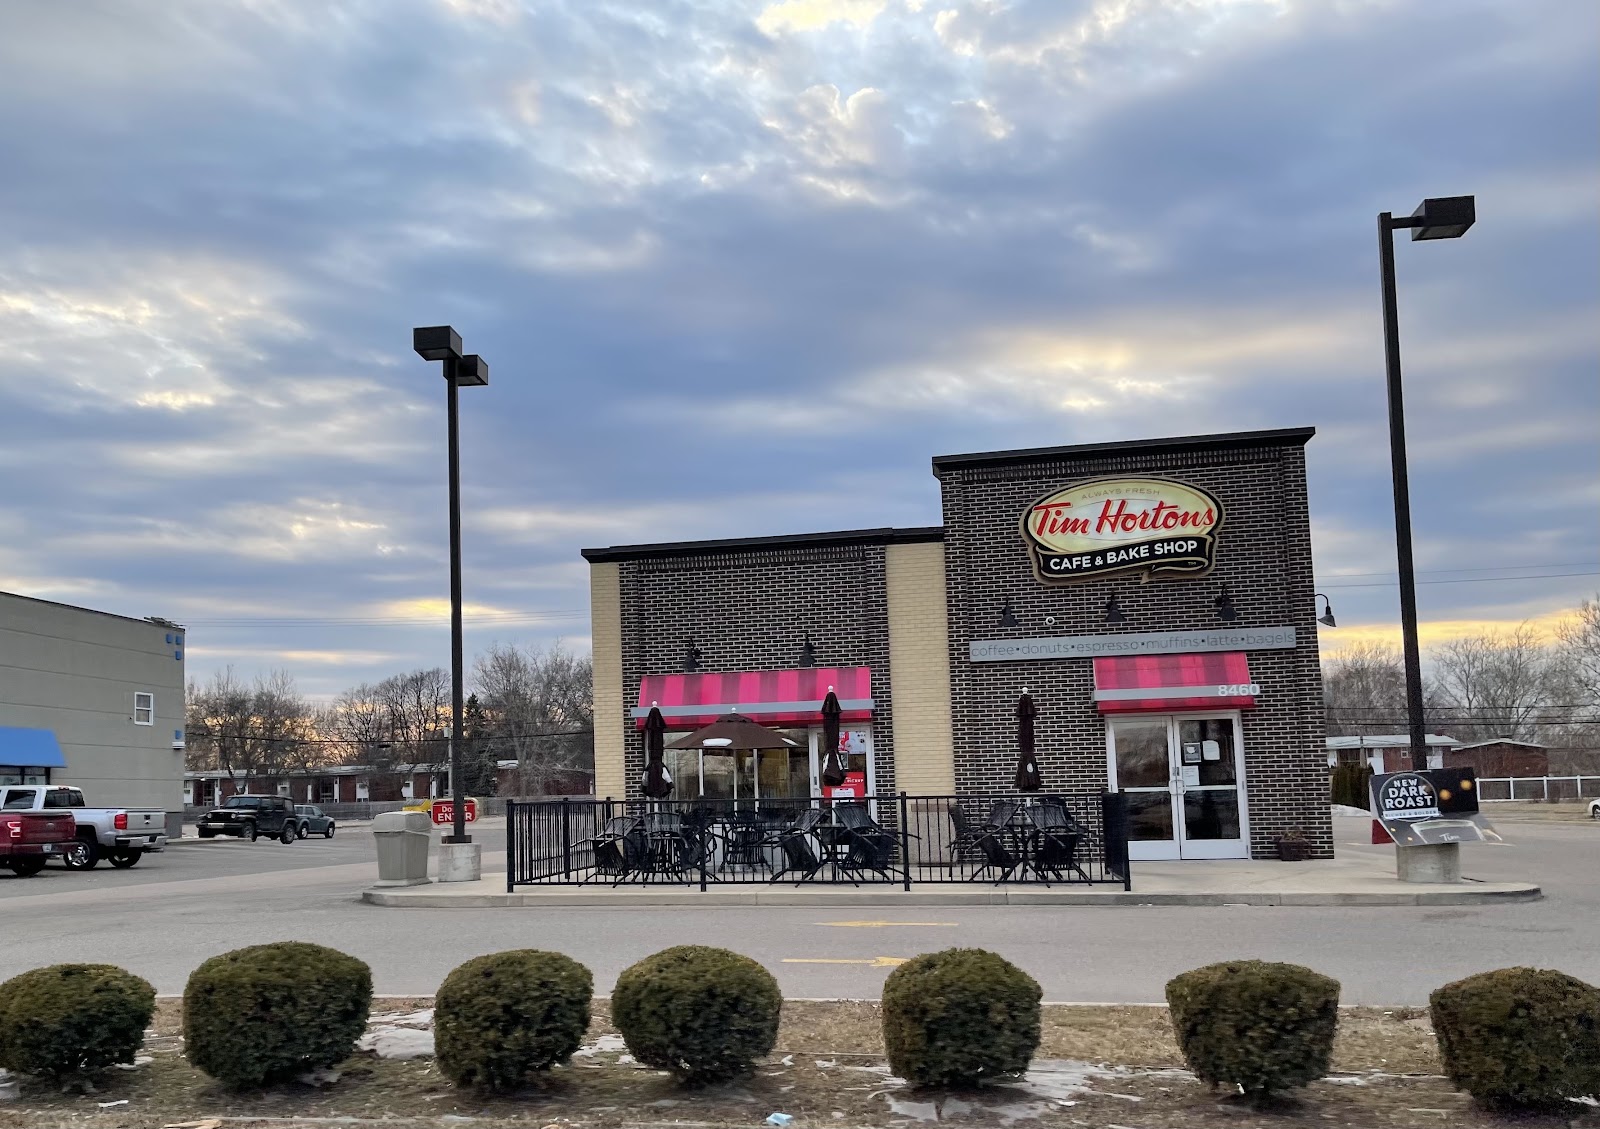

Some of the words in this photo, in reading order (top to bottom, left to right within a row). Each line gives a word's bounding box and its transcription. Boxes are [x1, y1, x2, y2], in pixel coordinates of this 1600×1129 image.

[1081, 488, 1122, 499] ALWAYS
[1033, 502, 1090, 537] Tim
[1095, 498, 1216, 535] Hortons
[1050, 556, 1092, 570] CAFE
[1095, 556, 1103, 565] &
[1107, 547, 1150, 564] BAKE
[1155, 541, 1198, 555] SHOP
[971, 645, 1015, 657] coffee
[1021, 643, 1069, 655] donuts
[1076, 640, 1138, 654] espresso
[1146, 637, 1199, 649] muffins
[1206, 635, 1239, 646] latte
[1245, 632, 1294, 646] bagels
[1218, 684, 1260, 696] 8460
[1394, 779, 1417, 787] NEW
[1388, 785, 1428, 798] DARK
[1384, 795, 1433, 809] ROAST
[438, 812, 472, 821] ENR
